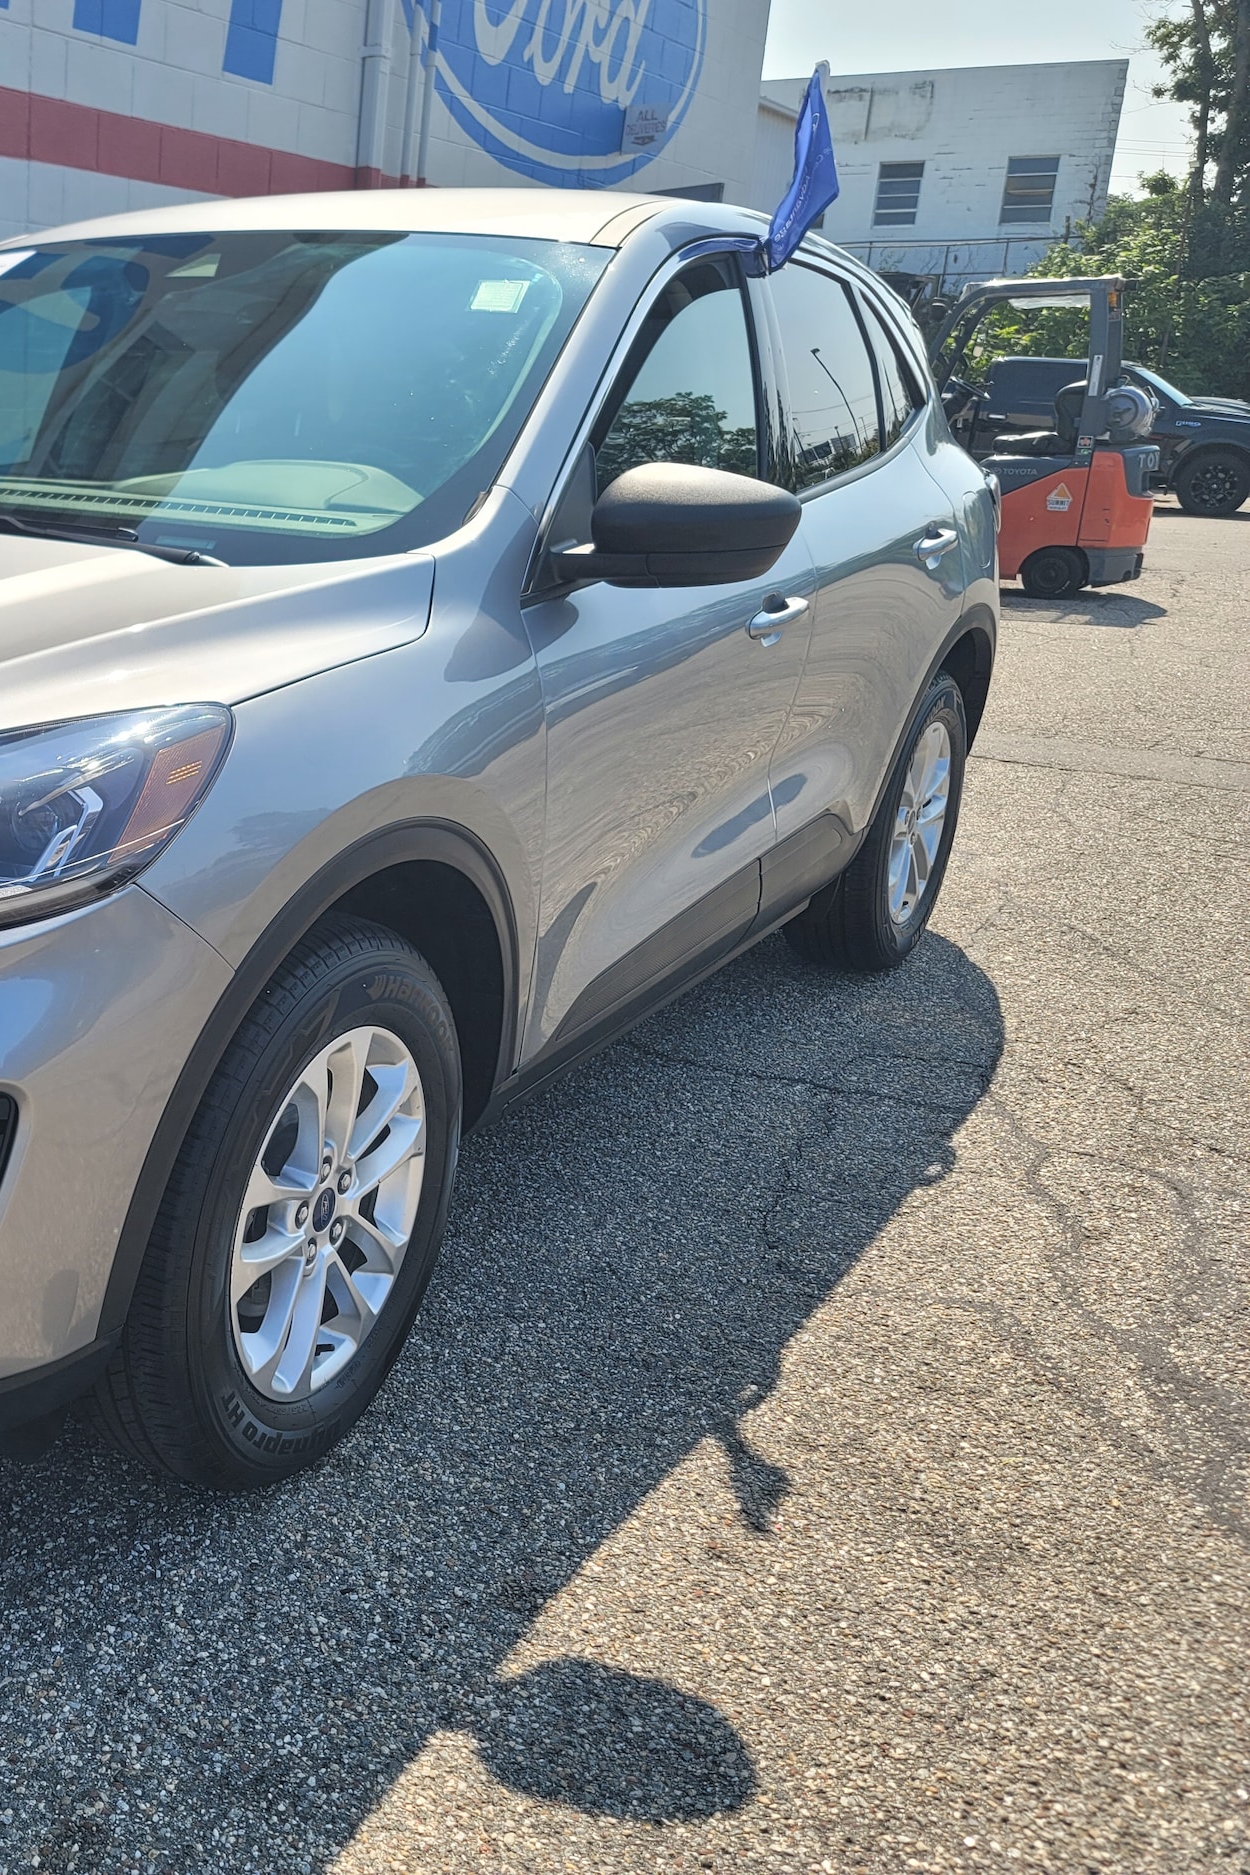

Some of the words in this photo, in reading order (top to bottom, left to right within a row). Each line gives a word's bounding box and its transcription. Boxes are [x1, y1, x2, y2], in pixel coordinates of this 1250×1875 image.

[636, 109, 658, 122] ALL
[1003, 467, 1038, 476] TOYOTA
[222, 1390, 246, 1428] HT
